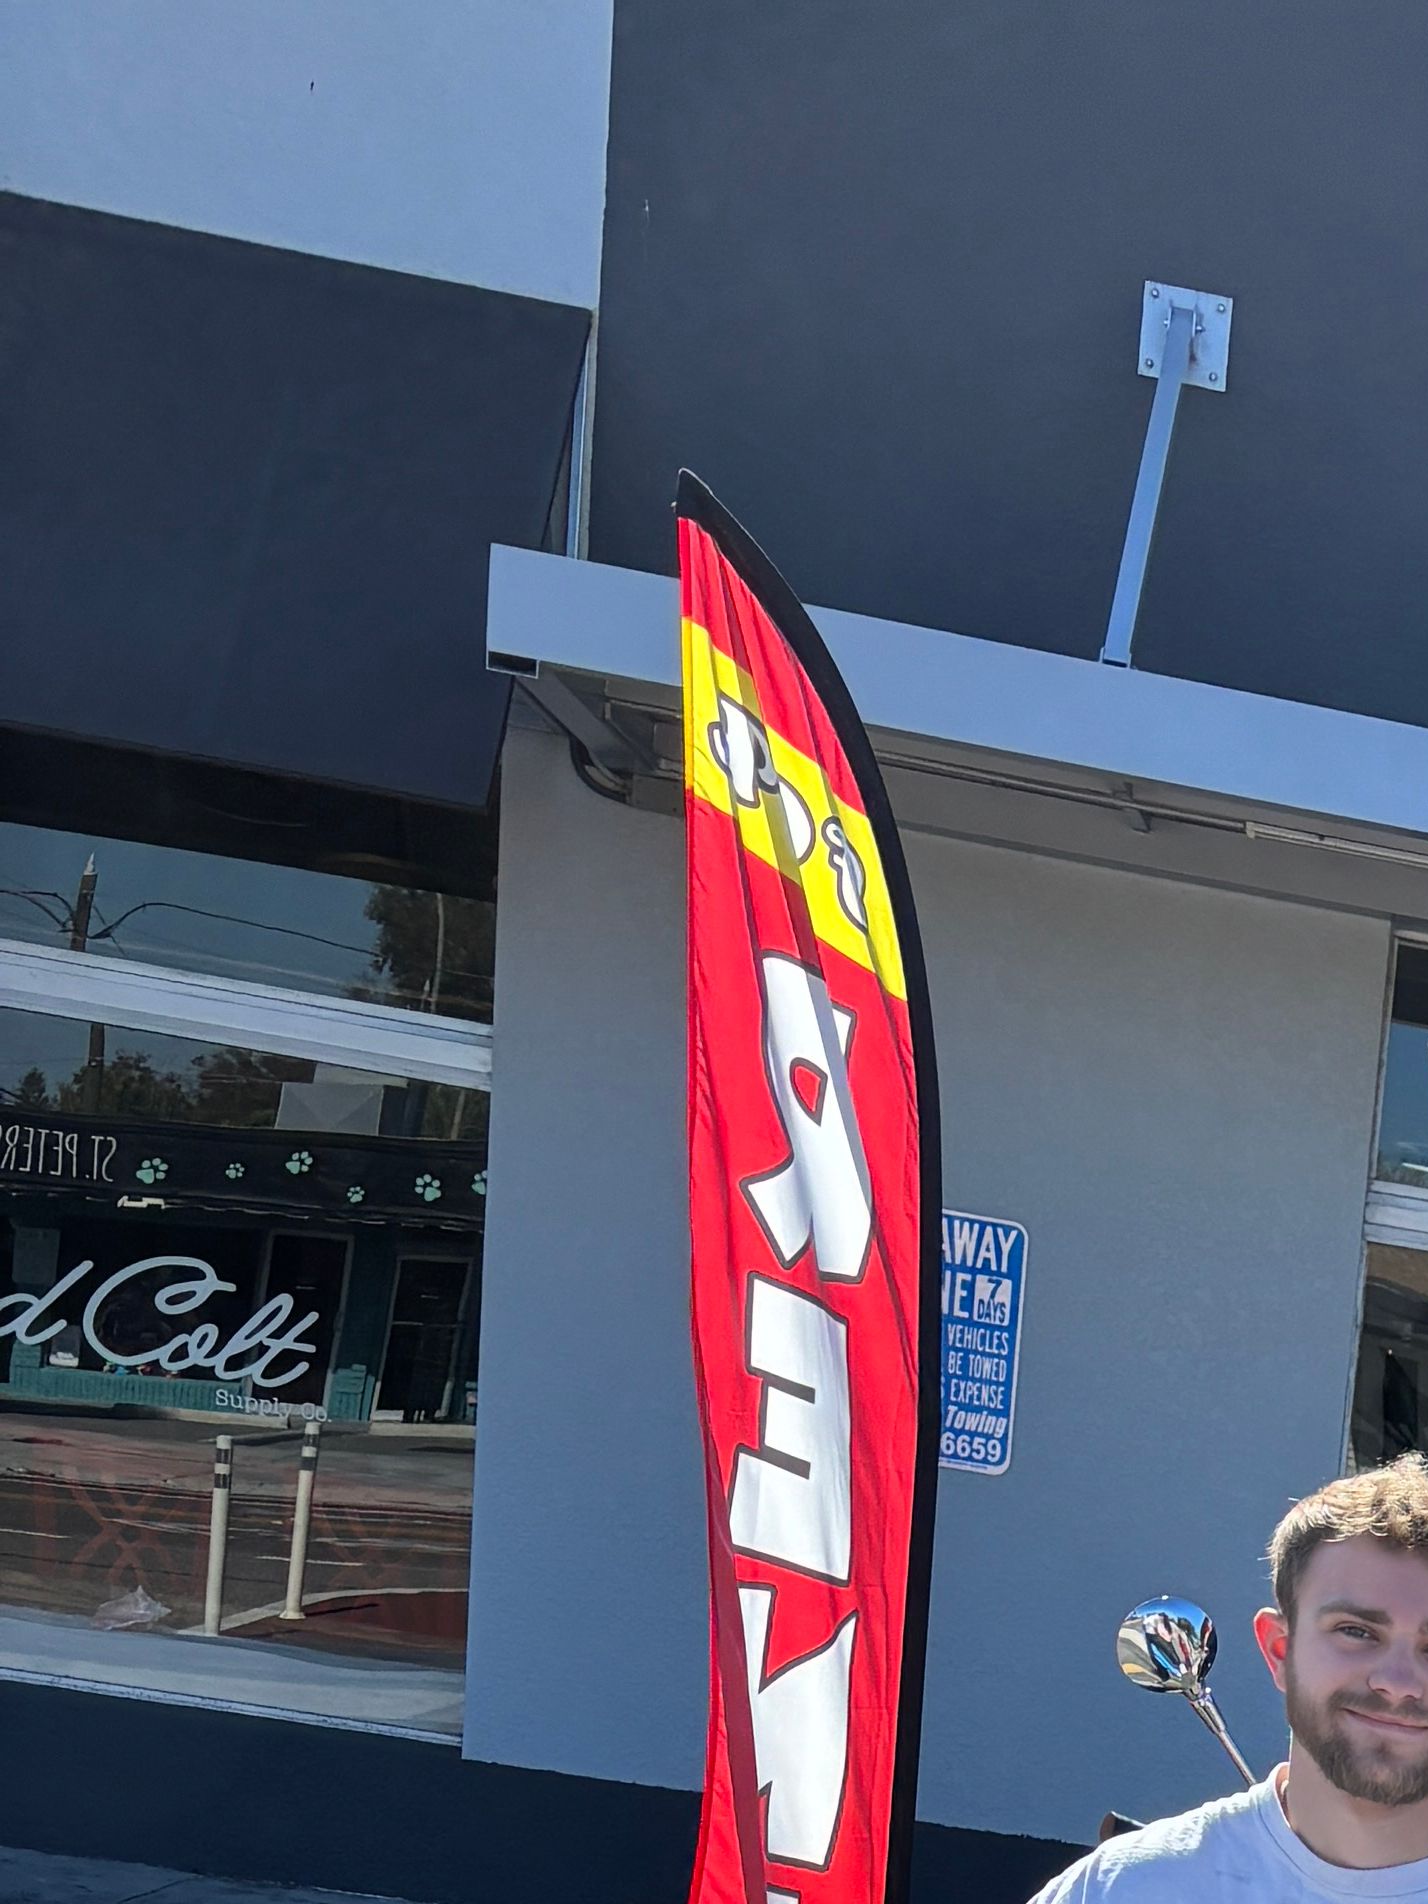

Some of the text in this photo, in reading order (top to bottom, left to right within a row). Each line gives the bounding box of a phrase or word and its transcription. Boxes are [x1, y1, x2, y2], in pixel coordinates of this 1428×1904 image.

[987, 1278, 1003, 1300] 7
[83, 1256, 320, 1388] Colt
[977, 1299, 1006, 1323] DAYS
[948, 1323, 1009, 1355] VEHICLES
[948, 1351, 1007, 1382] BE TOWED
[215, 1389, 332, 1422] Supply Co.
[950, 1378, 1005, 1409] EXPENSE
[945, 1404, 1008, 1438] Towing
[941, 1431, 1002, 1462] 6659
